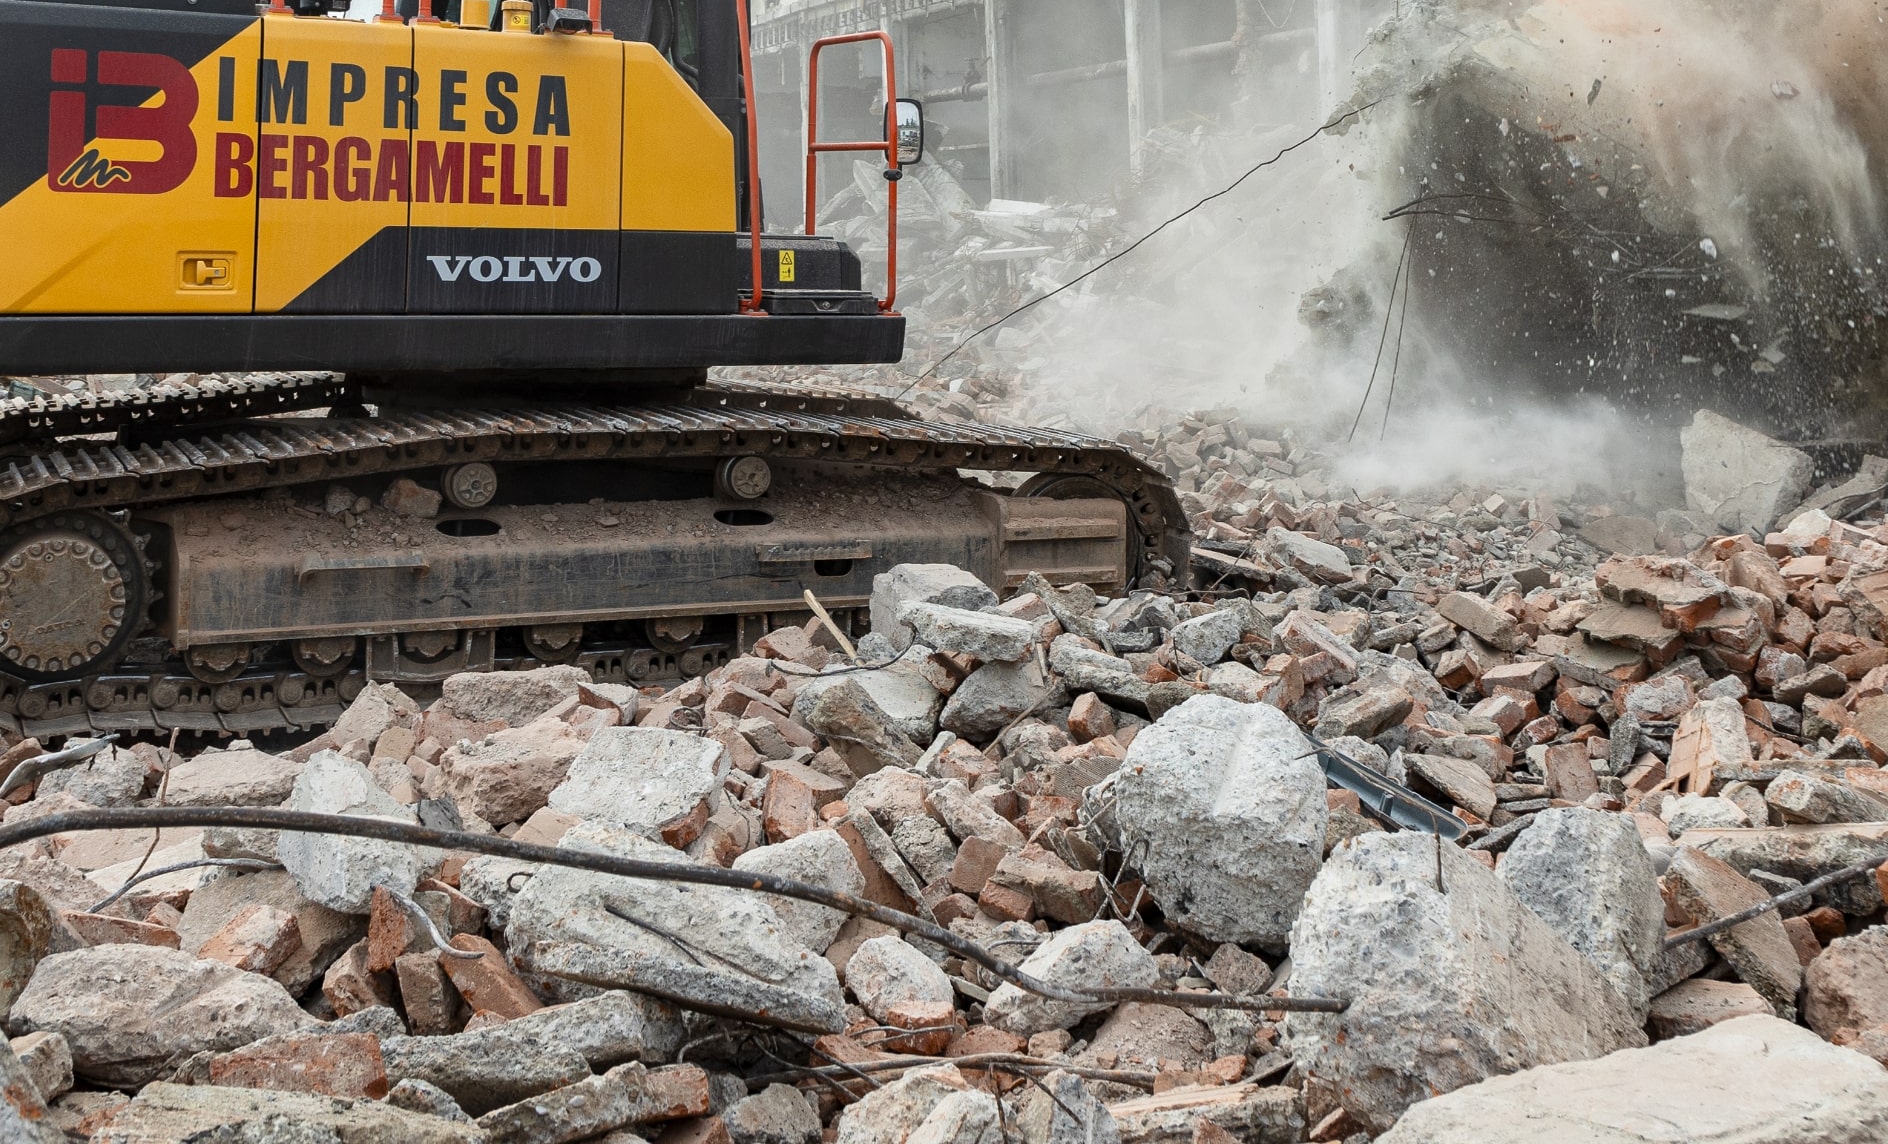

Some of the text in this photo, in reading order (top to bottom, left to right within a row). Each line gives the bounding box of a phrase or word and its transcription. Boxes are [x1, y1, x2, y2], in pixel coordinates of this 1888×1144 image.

[218, 56, 570, 136] IMPRESA
[214, 132, 568, 206] BERGAMELLI
[427, 256, 602, 282] VOLVO
